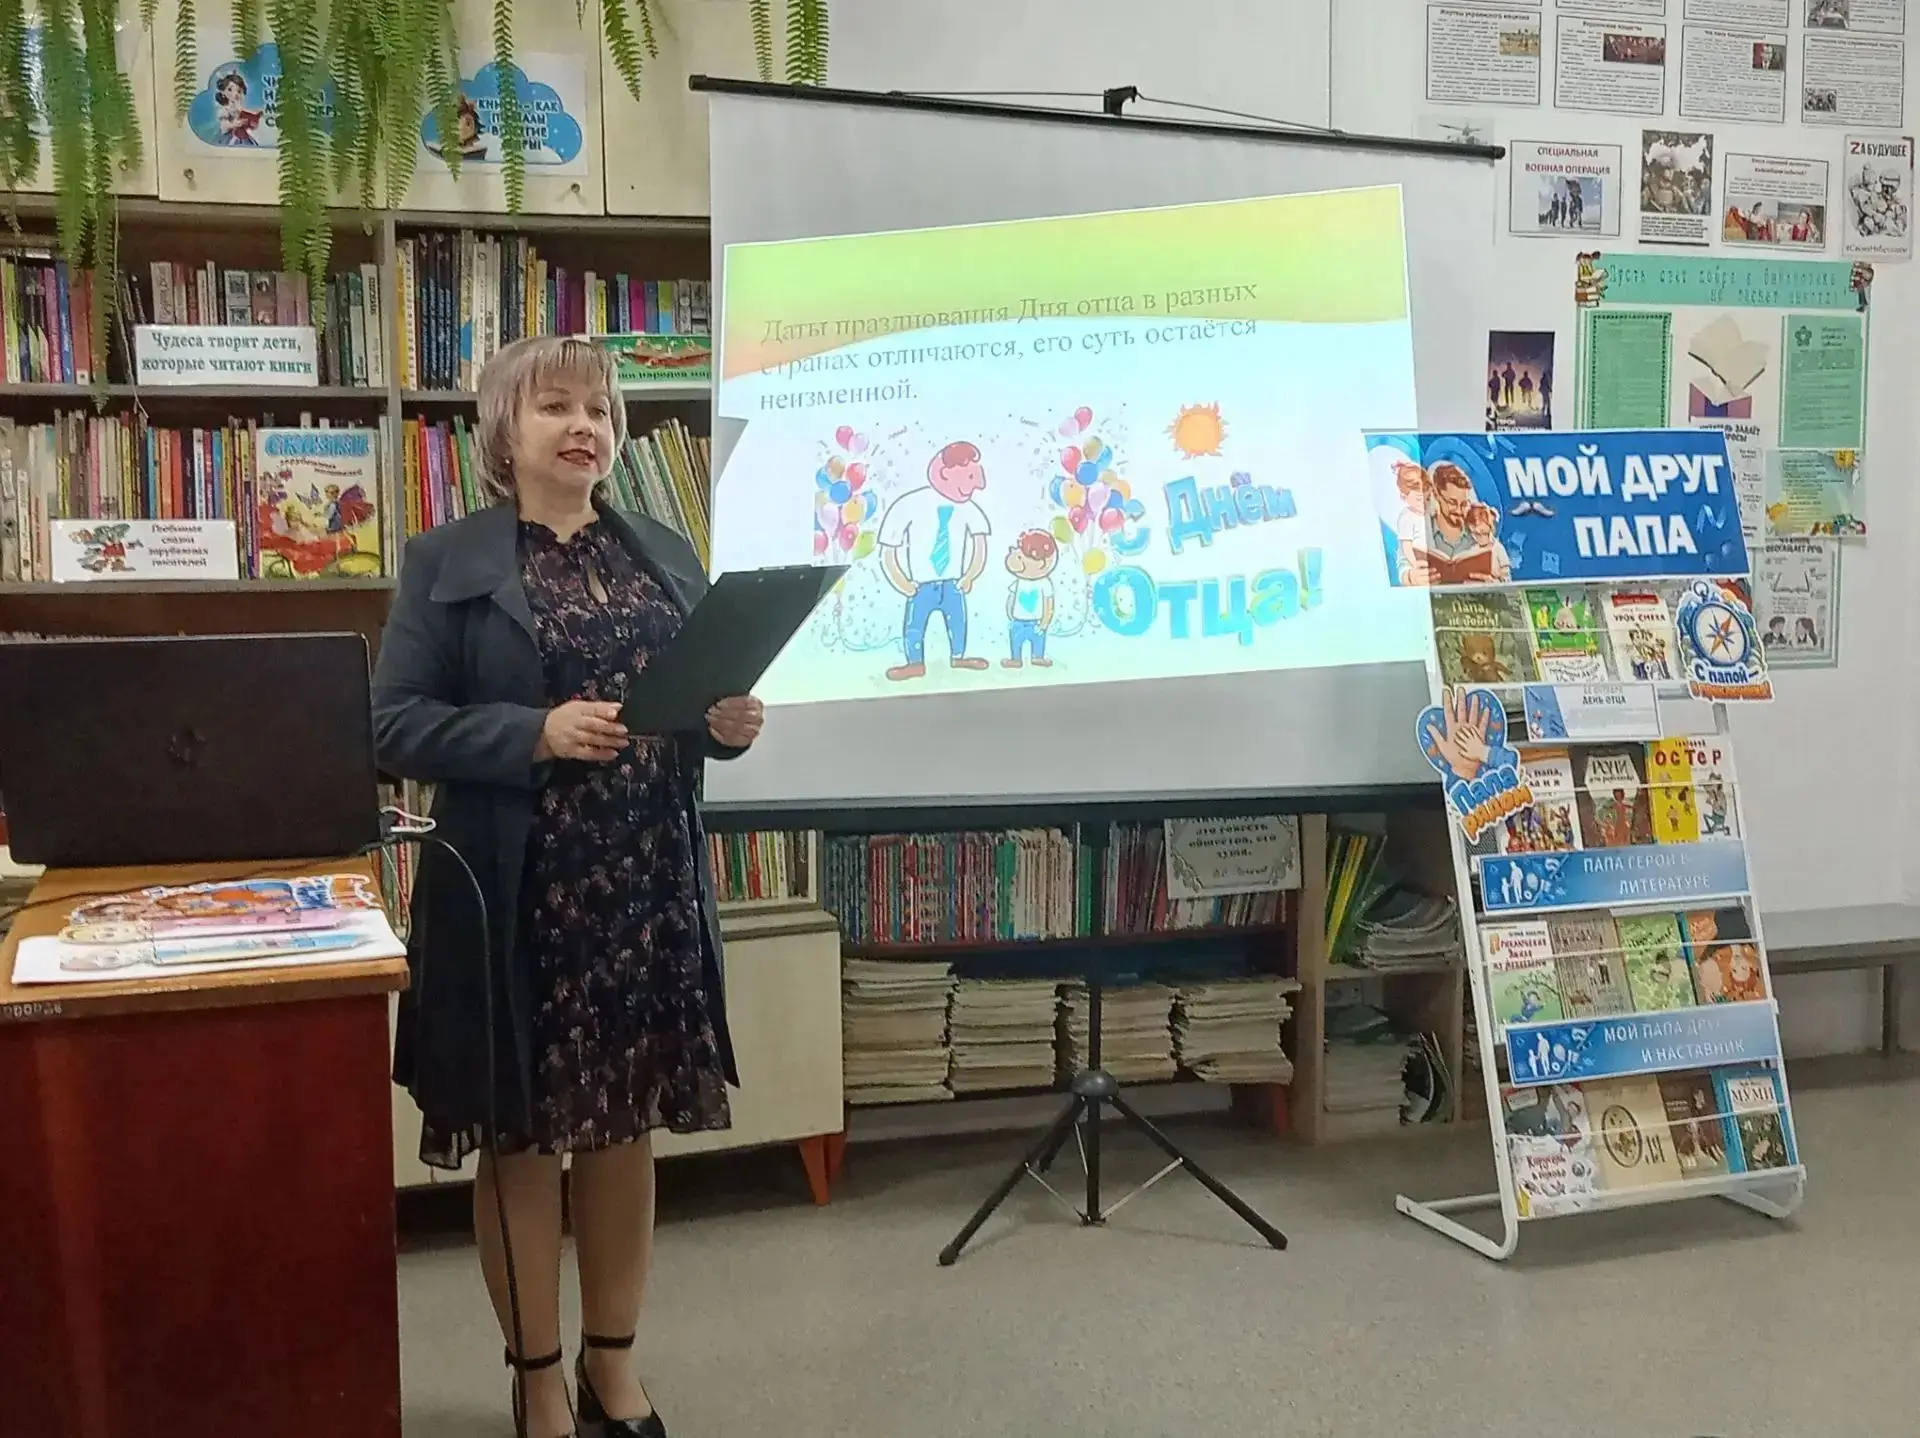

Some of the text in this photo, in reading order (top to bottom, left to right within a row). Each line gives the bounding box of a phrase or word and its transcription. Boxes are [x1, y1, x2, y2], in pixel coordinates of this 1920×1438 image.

[536, 101, 558, 112] КАК
[492, 112, 545, 124] ПАЛЫ
[1537, 146, 1598, 158] СПЕЦИАЛЬНАЯ
[1867, 143, 1907, 157] БУДУЩЕЕ
[1525, 163, 1610, 176] ВОЕННАЯ ОПЕРАЦИЯ
[760, 283, 1258, 344] Даты празднования Дня отца в разных
[152, 332, 302, 353] Чудеса творят дети,
[760, 319, 1257, 380] странах отличаются, его суть остаётся
[141, 359, 312, 374] которые читают книги
[760, 378, 918, 410] неизменной.
[264, 432, 369, 457] СКАЗКИ
[1504, 443, 1613, 498] МОЙ
[1620, 454, 1724, 502] ДРУГ
[1163, 471, 1297, 556] Днём
[1573, 514, 1699, 558] ПАПА
[1093, 547, 1324, 646] Отца!
[1452, 600, 1488, 615] Папа,
[1613, 613, 1665, 621] УРОК СМЕХА
[1708, 666, 1748, 684] папой
[1583, 695, 1626, 704] ДЕНЬ ОТЦА
[1450, 767, 1519, 816] Папа
[1584, 854, 1624, 874] ПАПА
[1620, 874, 1711, 895] ЛИТЕРАТУРЕ
[1604, 1022, 1639, 1044] МОЙ
[1641, 1021, 1682, 1039] ПАПА
[1641, 1039, 1745, 1064] И НАСТАВНИК
